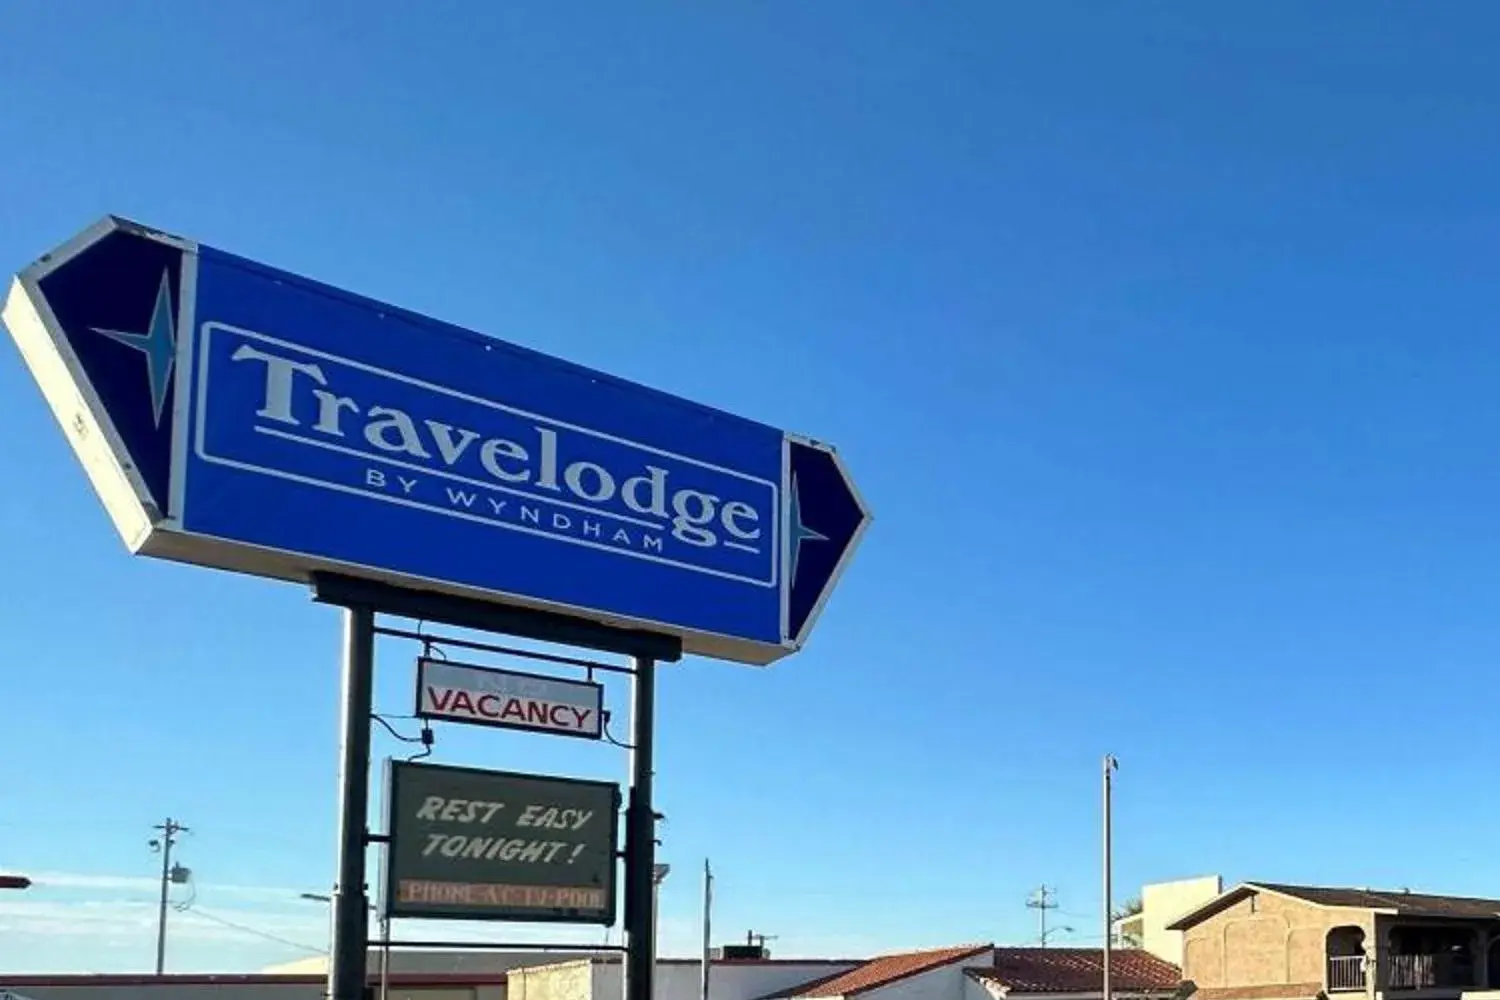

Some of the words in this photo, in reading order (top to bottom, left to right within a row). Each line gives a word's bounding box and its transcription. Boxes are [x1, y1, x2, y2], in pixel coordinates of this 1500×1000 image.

[232, 344, 761, 548] Travelodge
[365, 468, 418, 494] BY
[446, 487, 663, 553] WYNDHAM
[427, 686, 592, 728] VACANCY
[416, 796, 505, 823] REST
[515, 805, 593, 829] EASY
